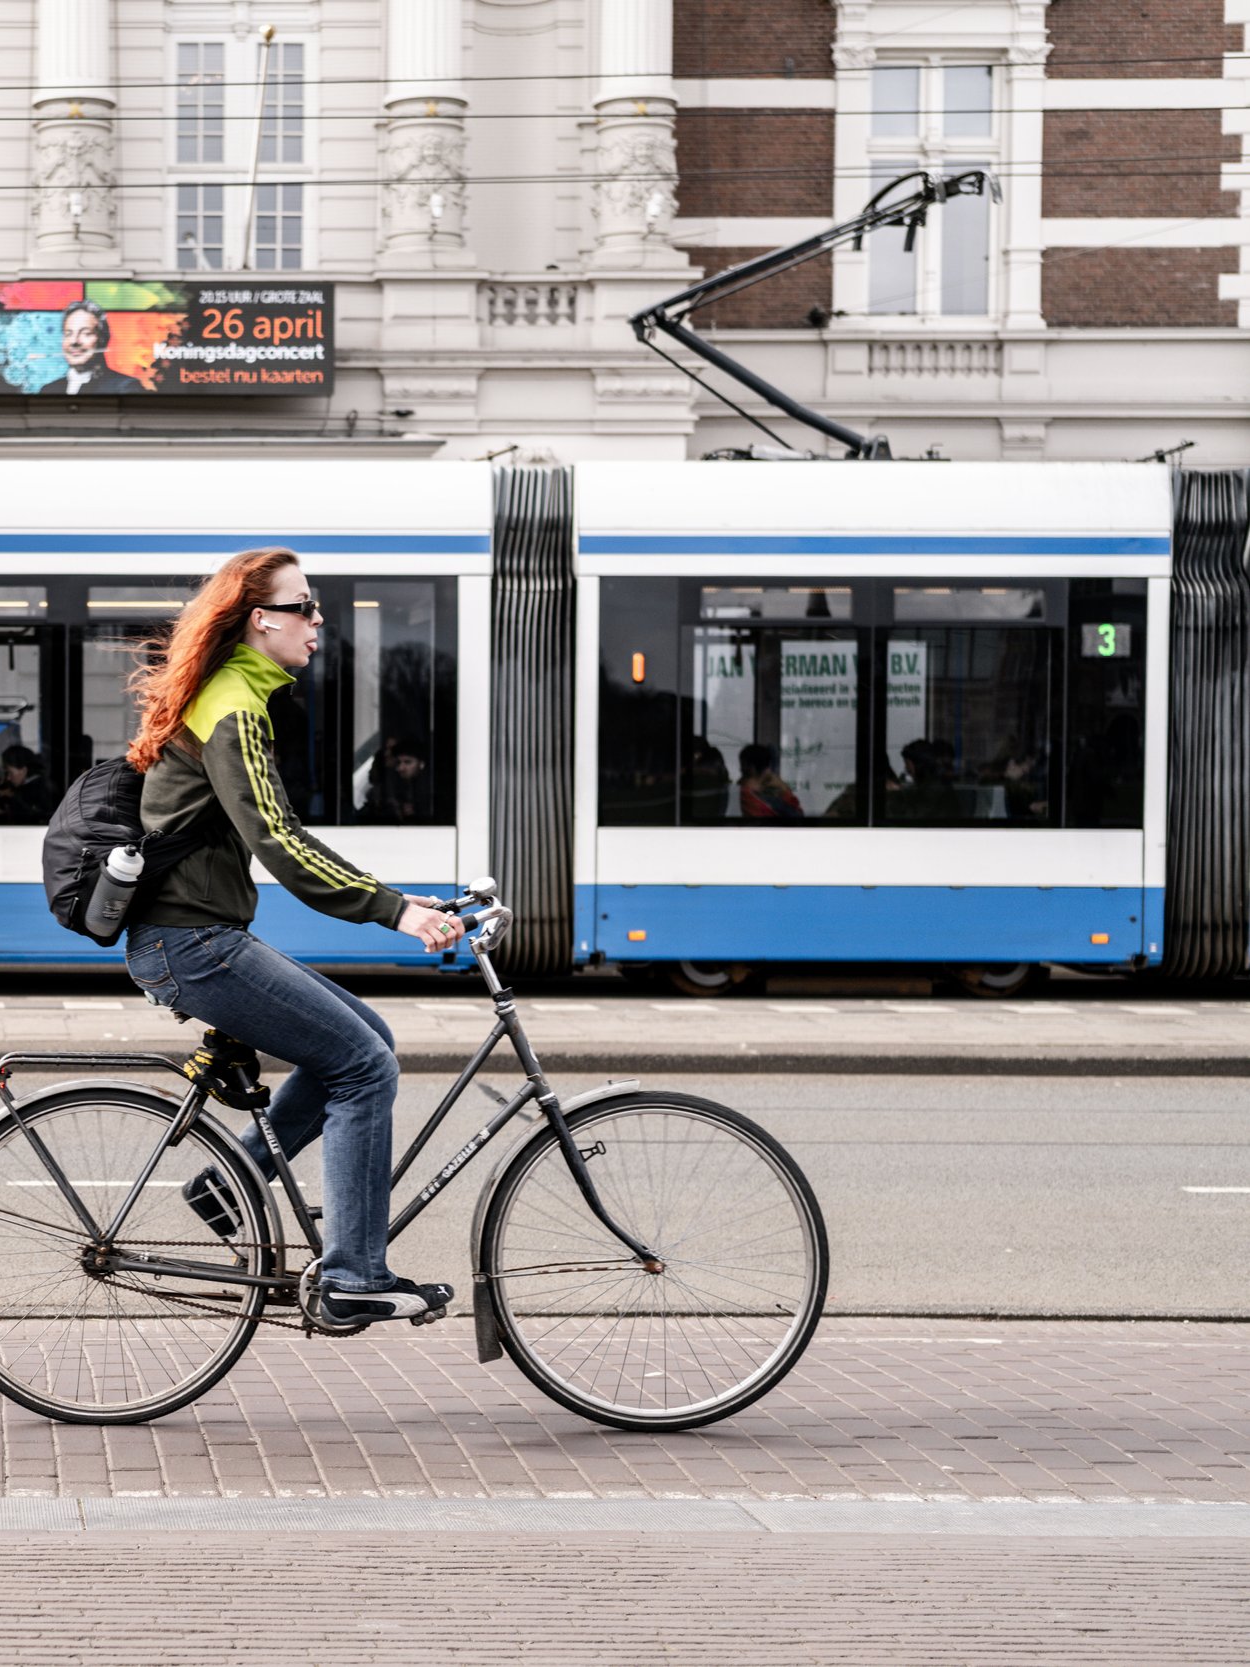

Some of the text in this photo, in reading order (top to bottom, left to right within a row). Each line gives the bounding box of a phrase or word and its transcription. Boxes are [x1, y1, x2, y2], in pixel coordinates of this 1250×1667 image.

[202, 308, 324, 346] 26 april
[153, 342, 325, 364] Koningsdagconcert
[180, 368, 324, 384] bestel nu kaarten
[1097, 623, 1116, 657] 3
[890, 653, 921, 676] B.V.
[258, 1116, 281, 1154] GAZELLE
[441, 1141, 478, 1178] GAZELLE
